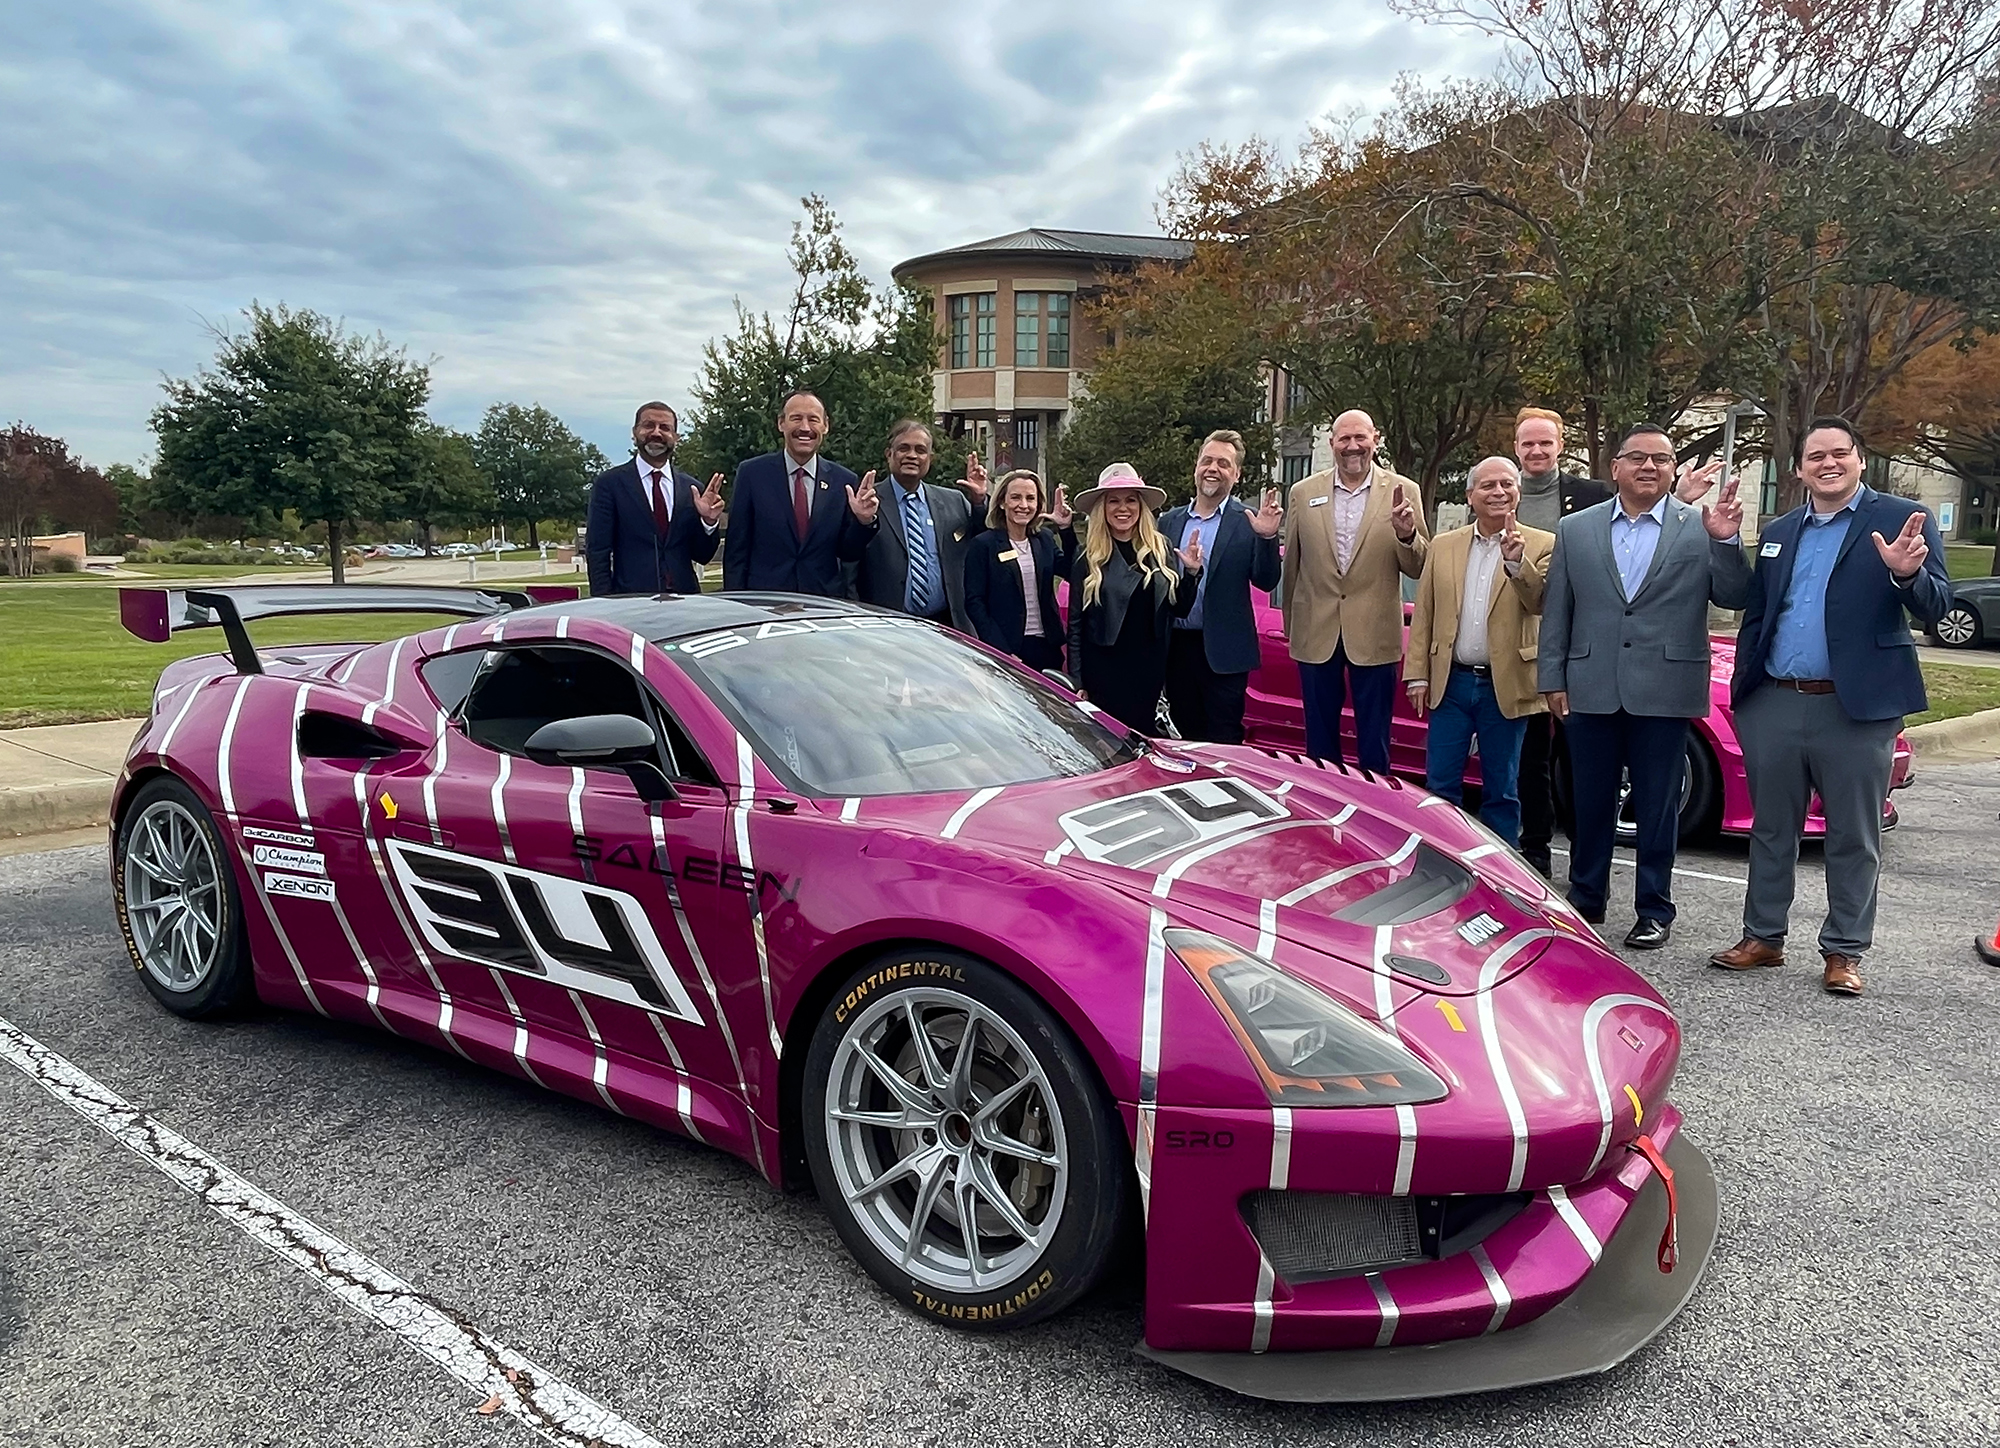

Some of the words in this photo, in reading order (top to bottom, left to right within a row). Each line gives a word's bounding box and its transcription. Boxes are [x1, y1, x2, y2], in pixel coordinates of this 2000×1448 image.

[244, 828, 314, 845] 3dCARBON
[1069, 781, 1282, 867] 34
[268, 848, 323, 868] Champion
[571, 834, 801, 903] SALEEN
[272, 878, 330, 896] XENON
[396, 847, 684, 1016] 34
[1457, 913, 1505, 946] MOTUL
[835, 962, 966, 1023] CONTINENTAL
[1166, 1130, 1235, 1149] SRO
[912, 1269, 1053, 1320] CONTINENTAL
